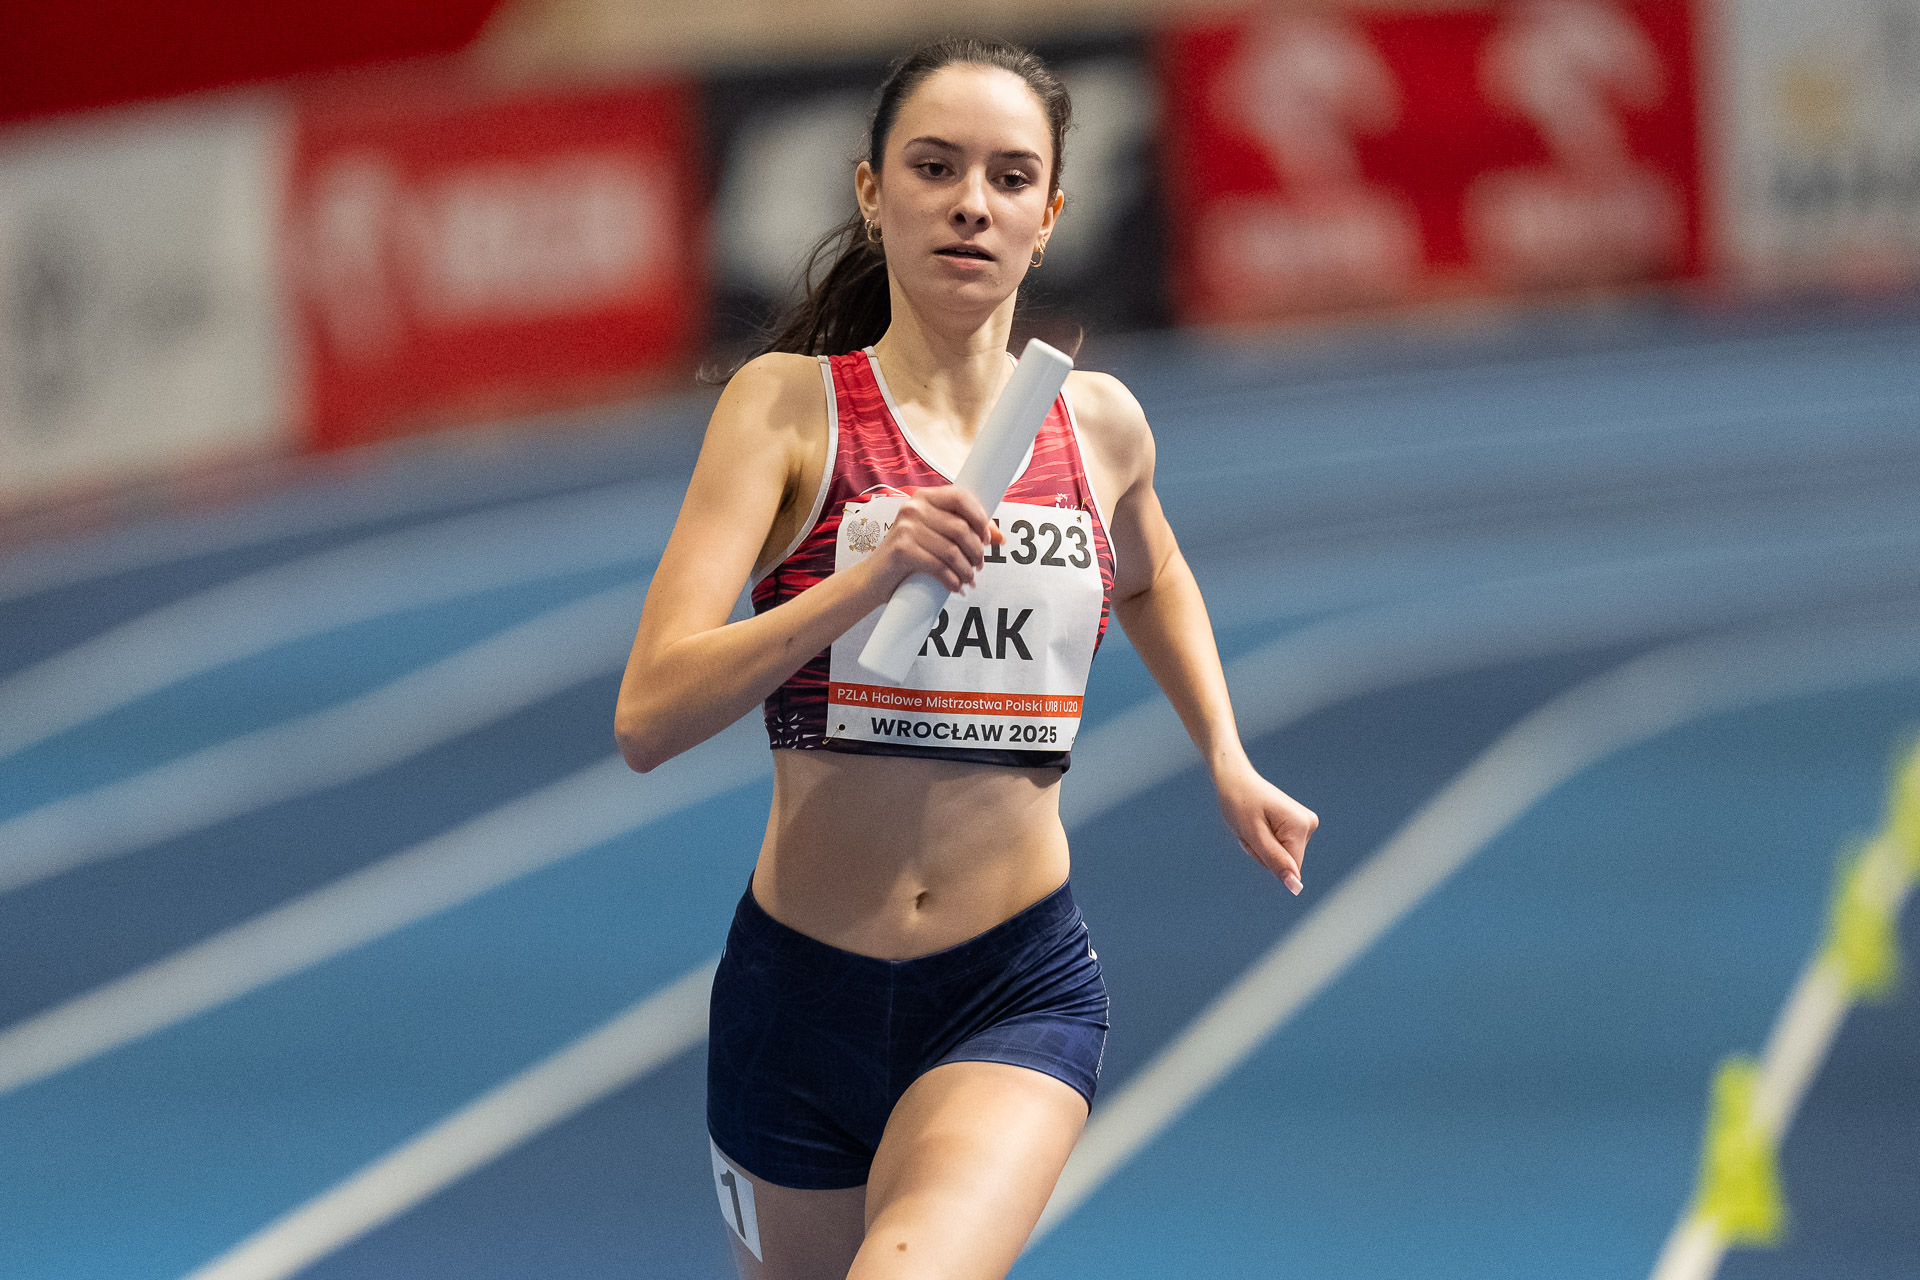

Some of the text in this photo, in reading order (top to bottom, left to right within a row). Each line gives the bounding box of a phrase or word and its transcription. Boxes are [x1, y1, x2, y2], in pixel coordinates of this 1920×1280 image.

[983, 518, 1092, 569] 1323
[837, 688, 868, 702] PZLA
[871, 692, 923, 707] Halowe
[926, 696, 1002, 710] Mistrzostwa
[1005, 699, 1042, 712] Polski
[1045, 701, 1059, 713] U18
[1063, 701, 1078, 713] U20
[871, 717, 1057, 743] WROCŁAW 2025
[721, 1169, 746, 1241] 1
